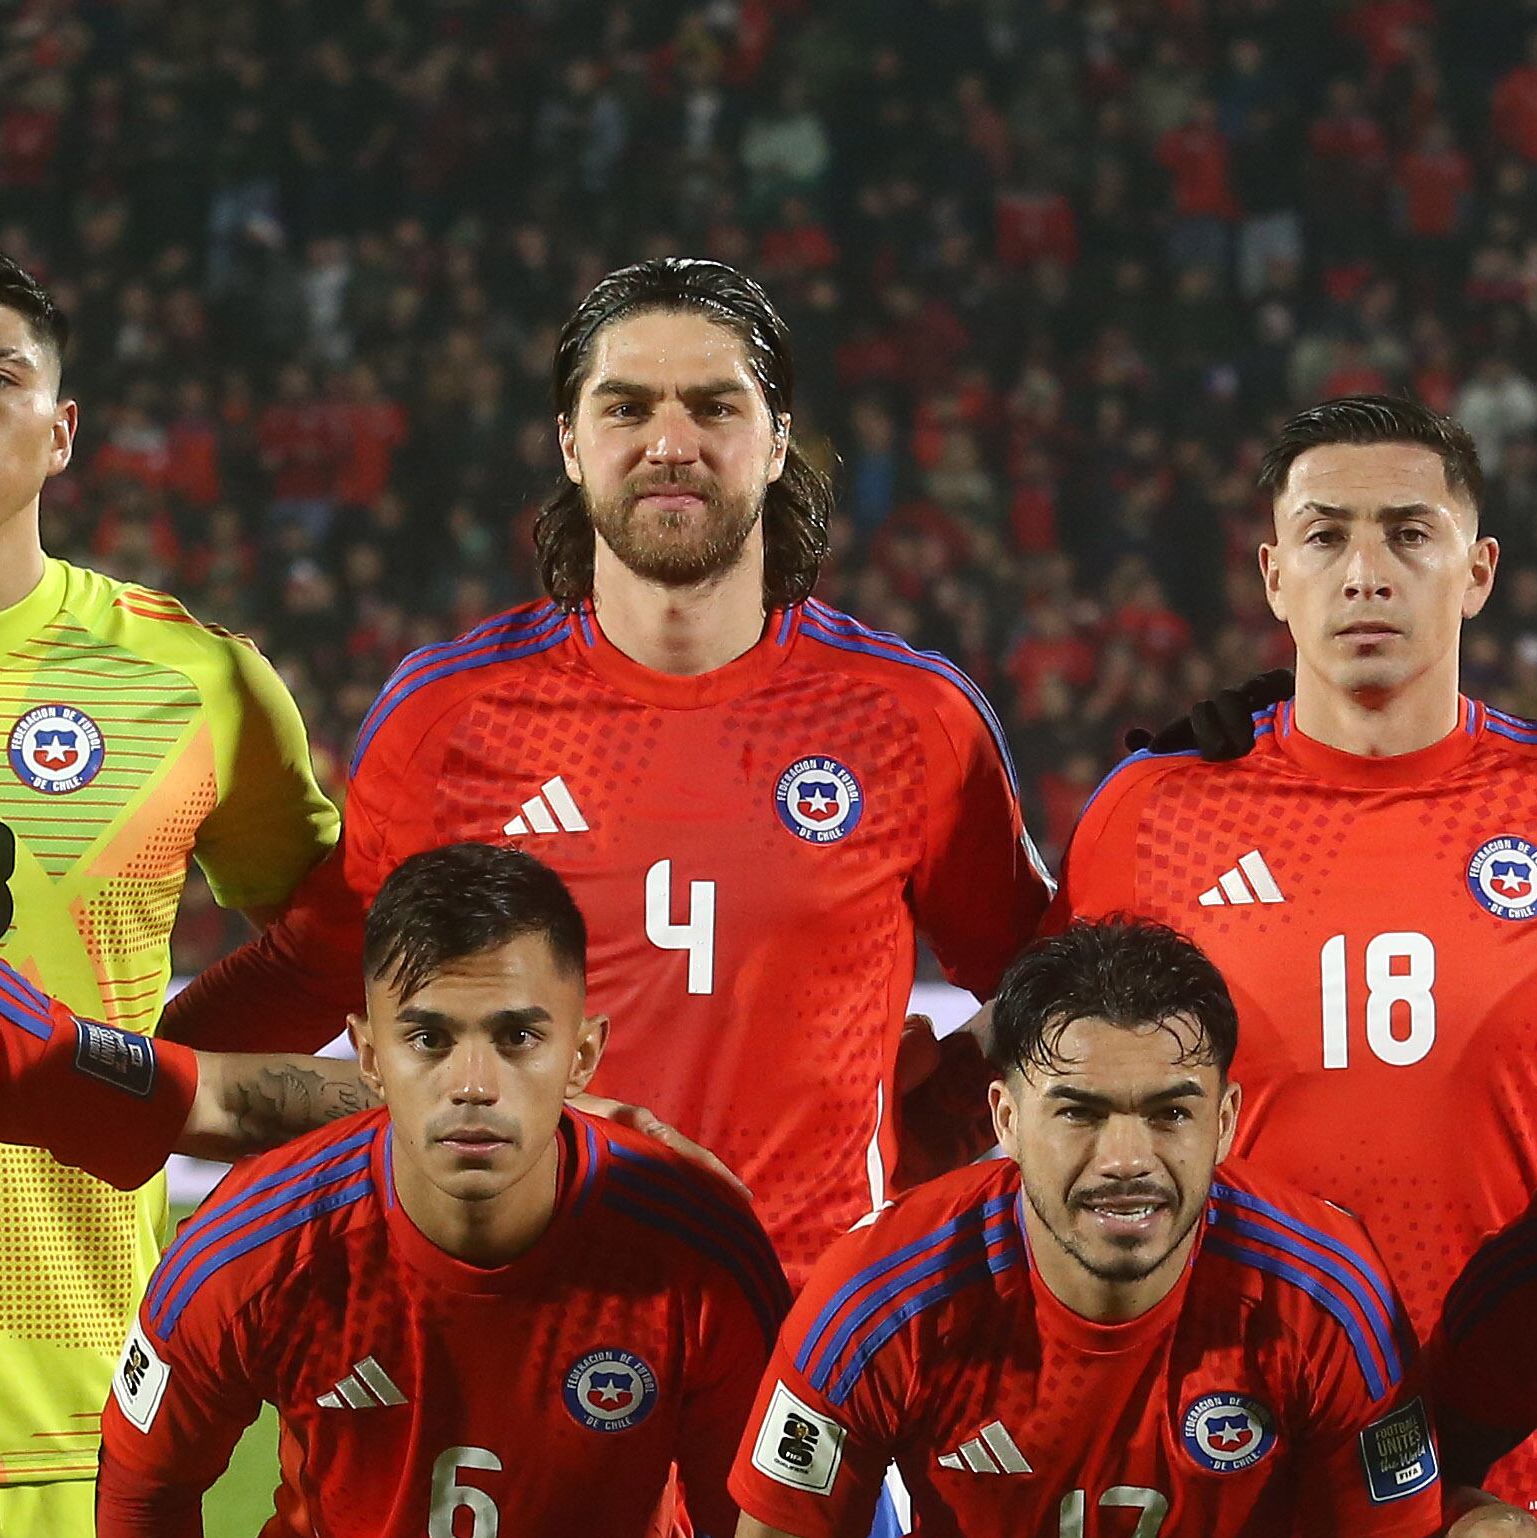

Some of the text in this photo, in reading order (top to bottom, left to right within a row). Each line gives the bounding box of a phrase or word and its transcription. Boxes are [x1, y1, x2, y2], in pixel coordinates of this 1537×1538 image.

[63, 708, 77, 720] DE
[823, 761, 836, 772] DE
[33, 776, 81, 791] DE CHILE
[799, 827, 843, 841] DE CHILE
[1518, 842, 1530, 853] DE
[1491, 904, 1534, 918] DE CHILE
[645, 859, 715, 994] 4
[1321, 931, 1436, 1069] 18
